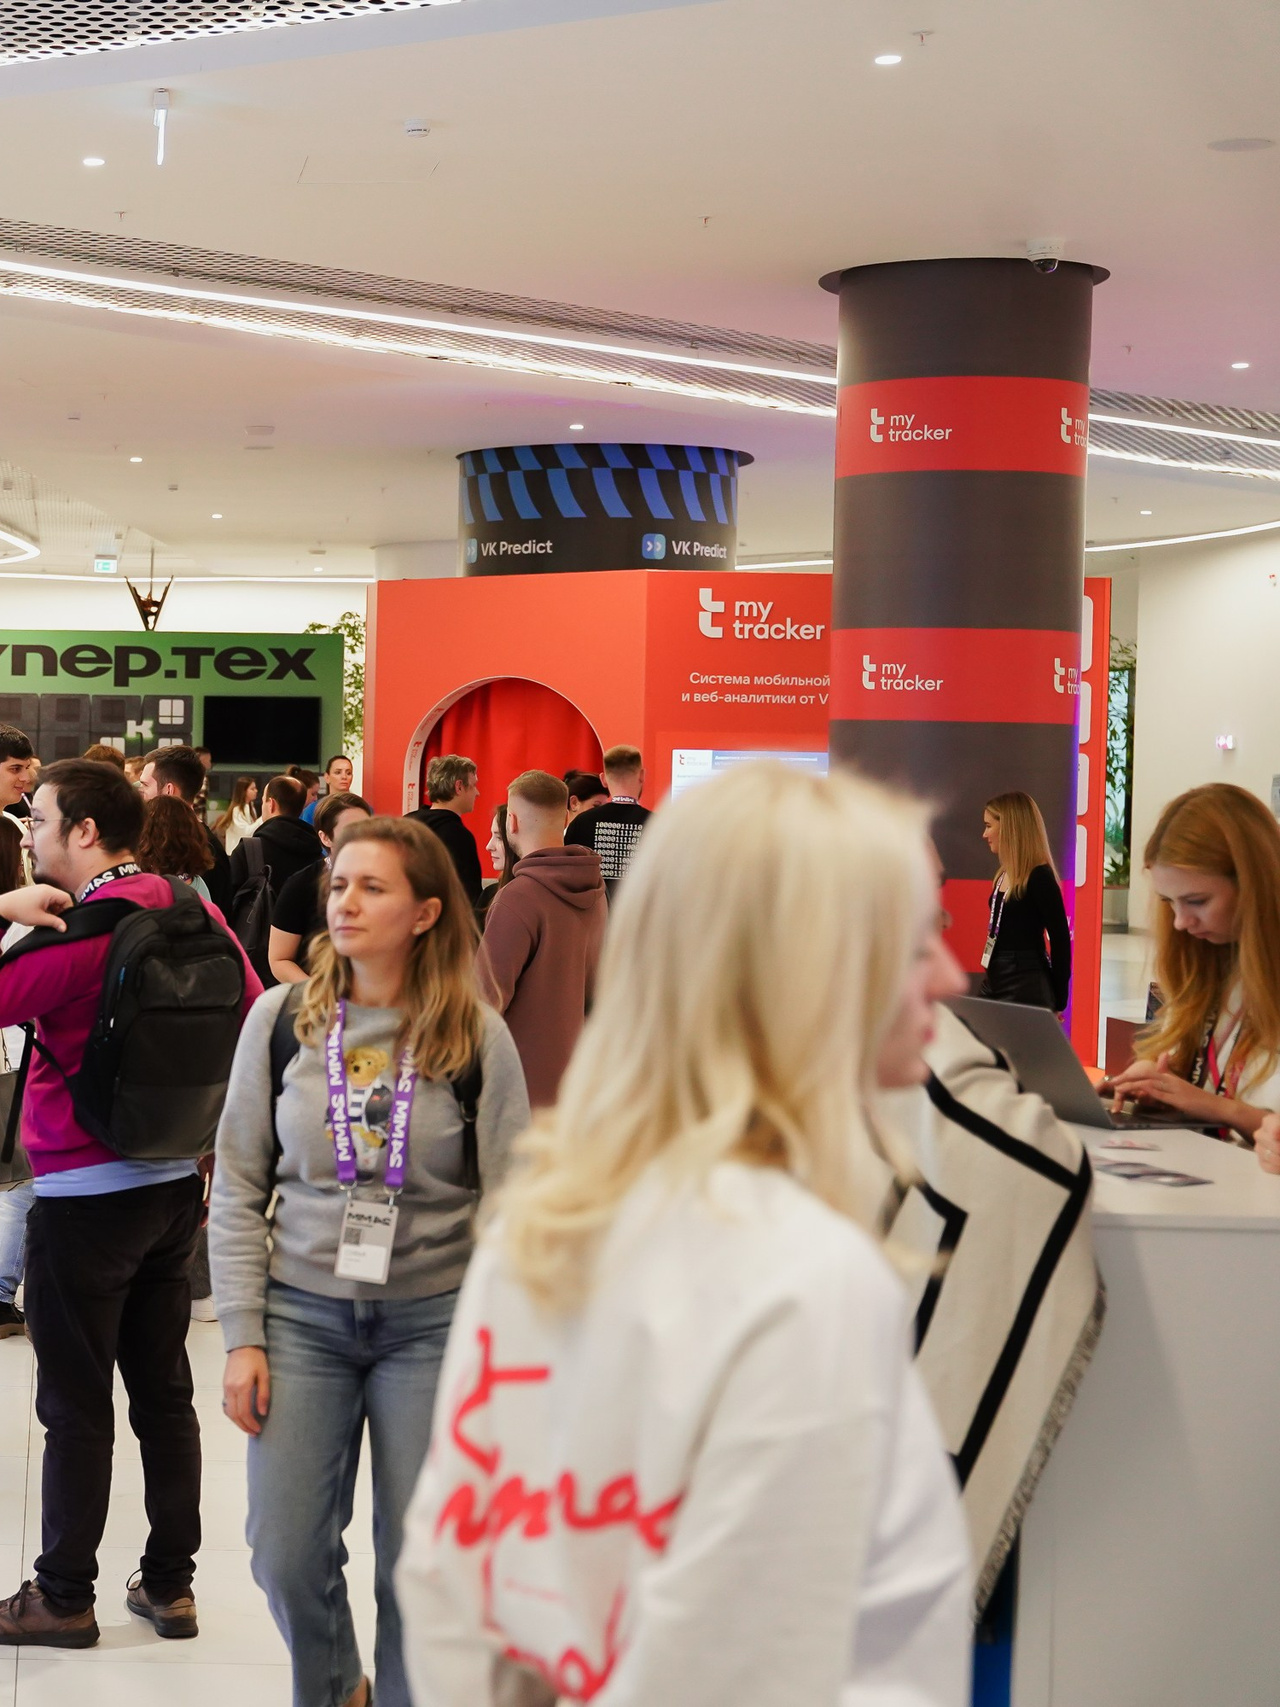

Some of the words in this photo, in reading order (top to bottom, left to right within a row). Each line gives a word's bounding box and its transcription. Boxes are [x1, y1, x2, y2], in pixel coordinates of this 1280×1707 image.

[890, 414, 915, 429] my
[888, 424, 953, 442] tracker
[481, 541, 497, 557] VK
[499, 539, 553, 556] Predict
[672, 540, 691, 556] VK
[693, 542, 727, 560] Predict
[734, 600, 774, 623] my
[733, 617, 826, 640] tracker
[689, 672, 750, 685] Система
[754, 674, 831, 687] мобильной
[882, 663, 907, 679] my
[880, 674, 944, 691] tracker
[681, 692, 690, 702] и
[694, 691, 796, 704] веб-аналитики
[799, 695, 815, 704] от
[819, 693, 830, 705] V
[389, 1100, 410, 1169] MMAS
